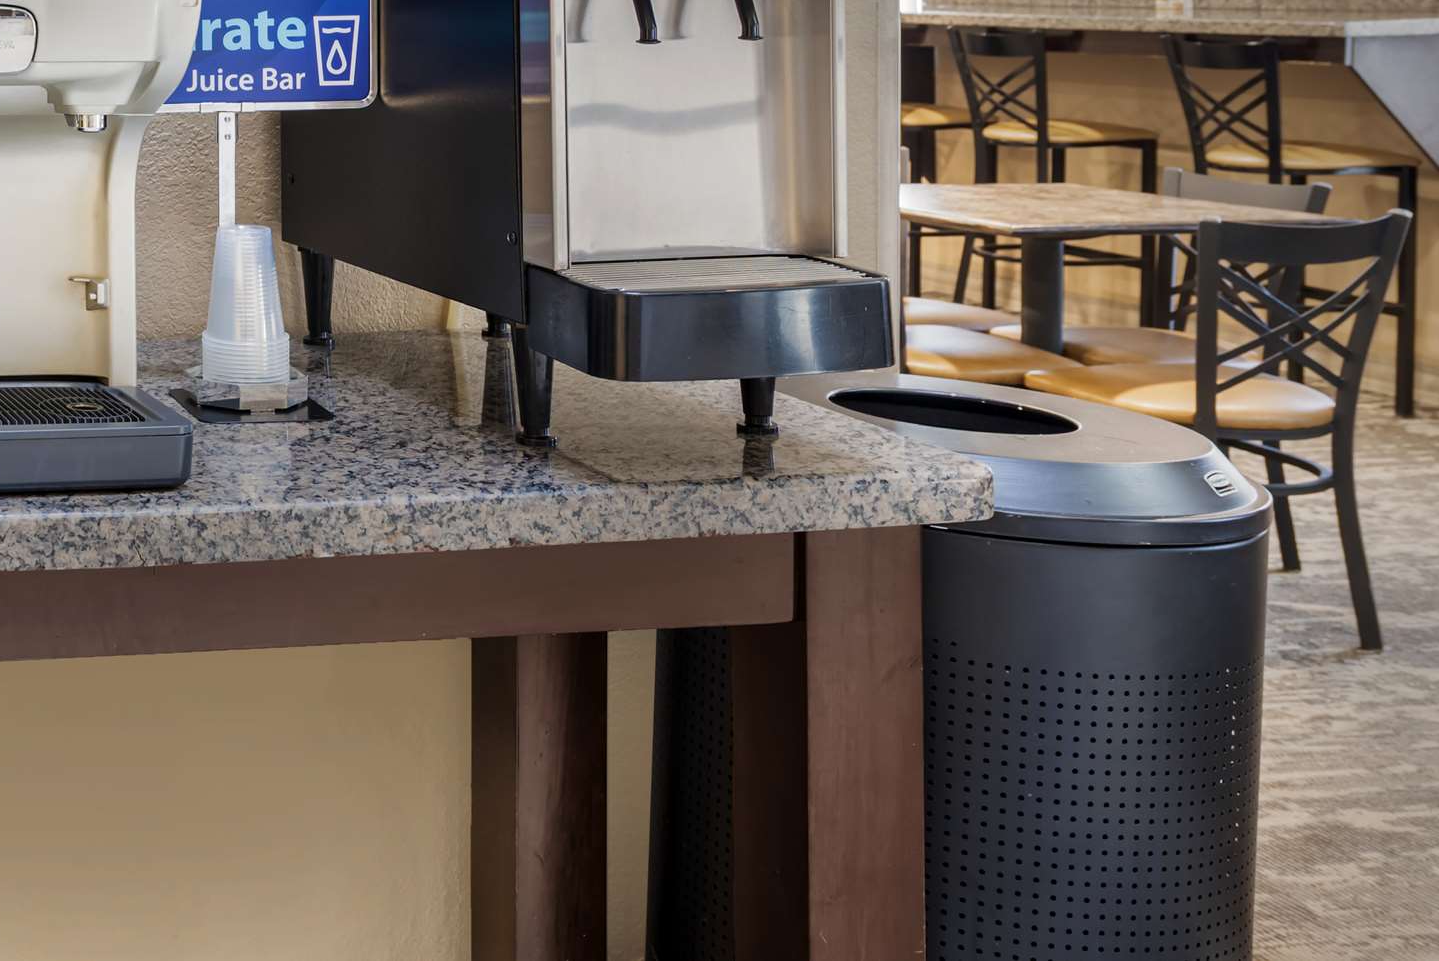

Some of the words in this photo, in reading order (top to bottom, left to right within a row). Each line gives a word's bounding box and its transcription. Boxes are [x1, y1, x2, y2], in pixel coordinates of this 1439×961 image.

[193, 10, 307, 52] rate
[186, 67, 255, 93] Juice
[261, 67, 307, 92] Bar
